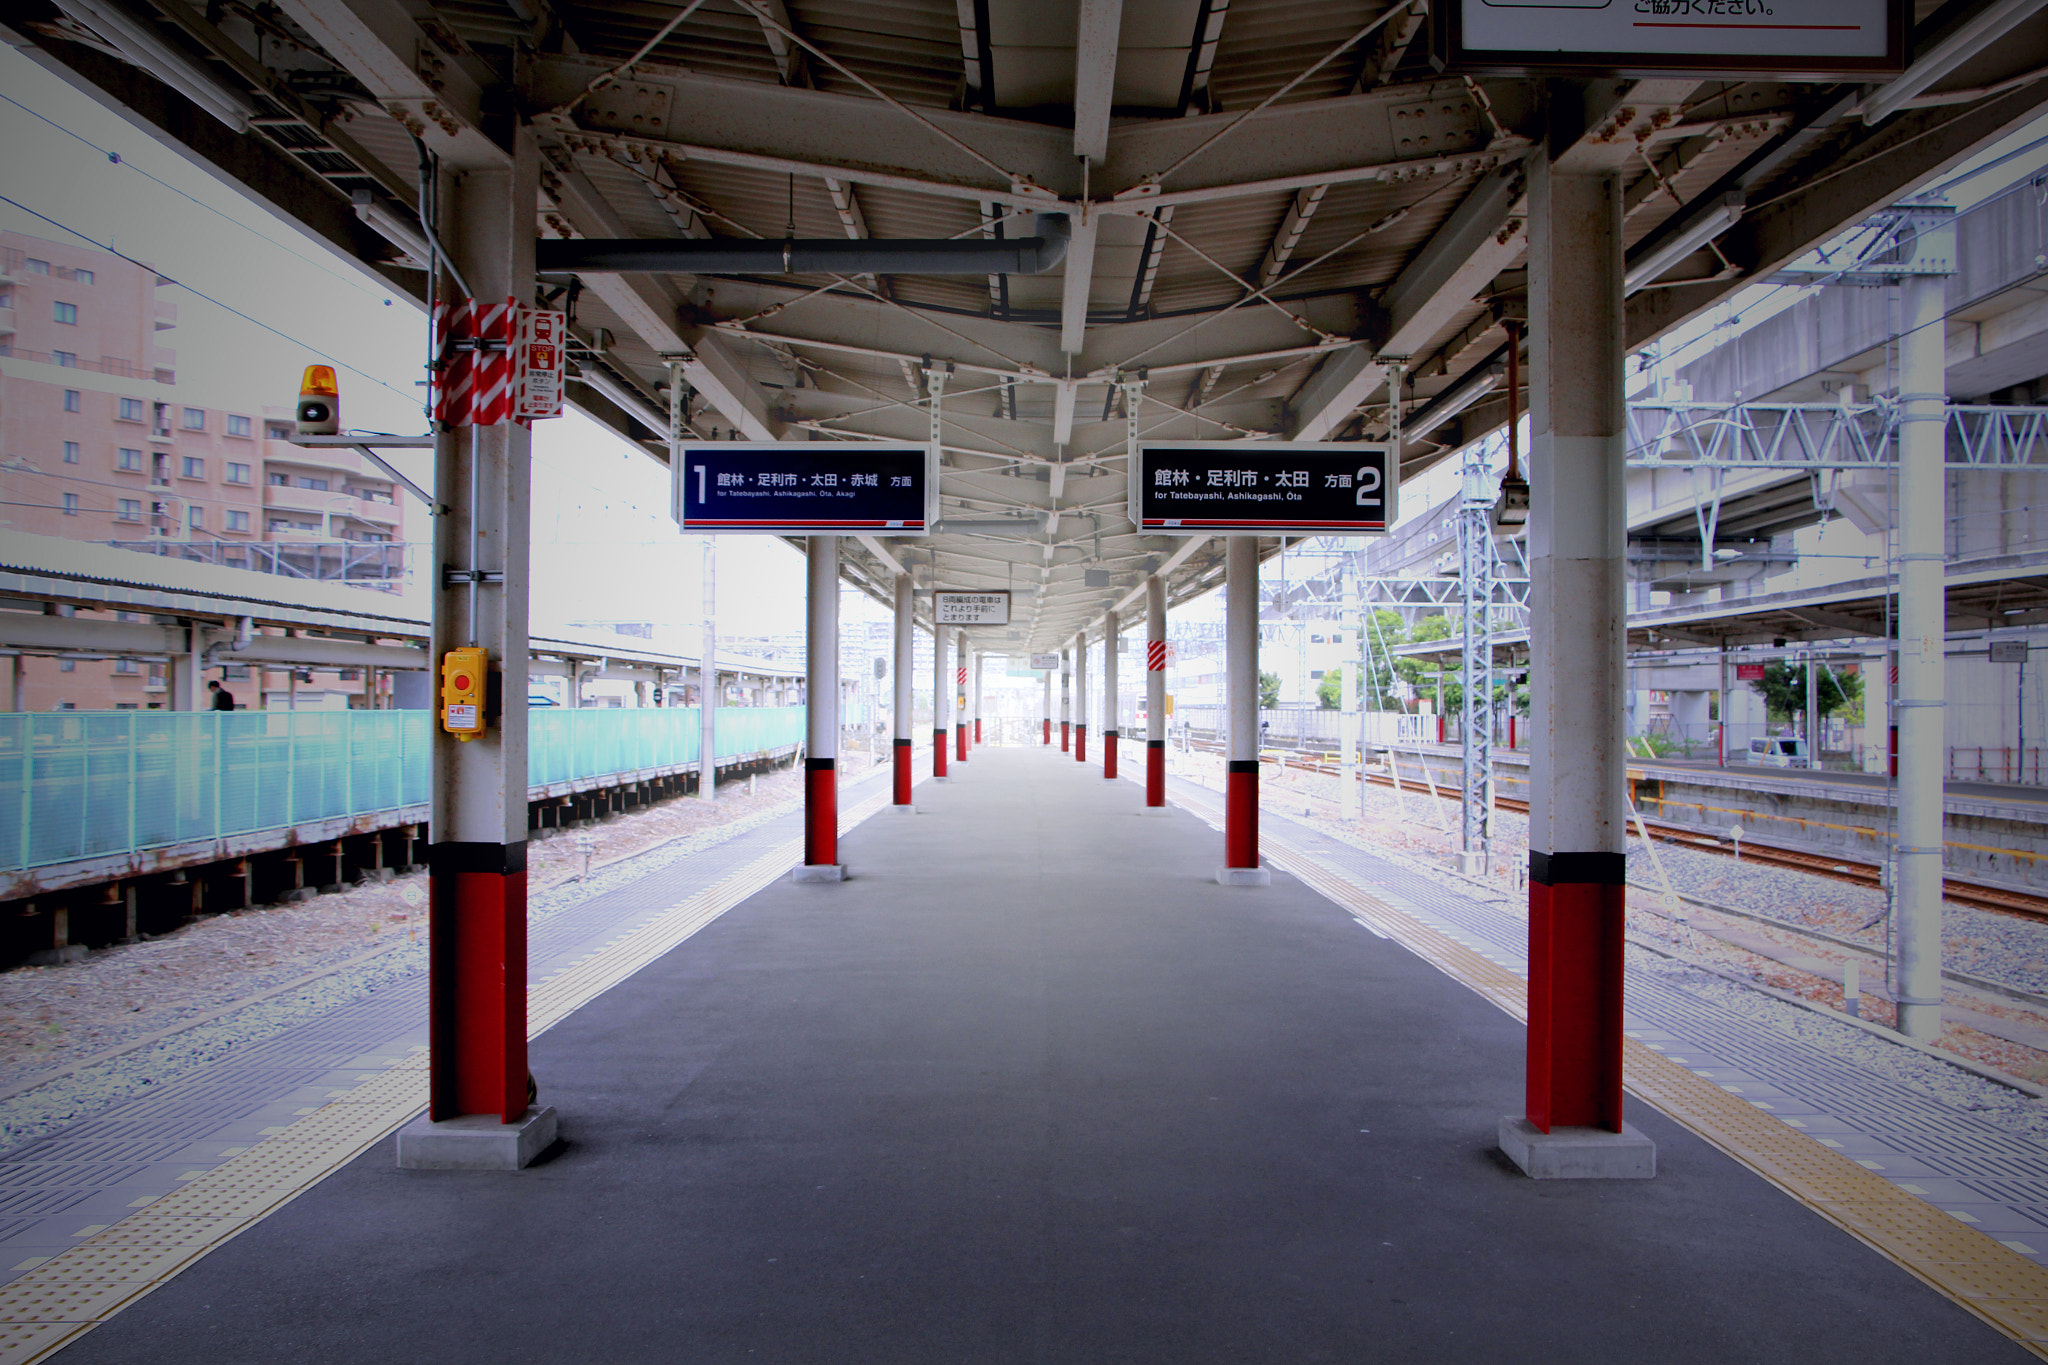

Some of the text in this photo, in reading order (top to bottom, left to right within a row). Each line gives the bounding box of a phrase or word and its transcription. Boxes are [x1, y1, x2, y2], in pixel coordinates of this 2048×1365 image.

[694, 465, 706, 504] 1
[717, 473, 912, 487] 館林・足利市・太田・赤城 方面
[1154, 469, 1352, 488] 館林・足利市・太田 方面
[1356, 466, 1381, 506] 2
[729, 490, 771, 498] Tatebayashi,
[773, 490, 817, 498] Ashikagashi,
[836, 490, 856, 498] Akagi
[1155, 491, 1167, 499] for
[1170, 491, 1225, 501] Tatebayashi,
[1227, 492, 1284, 502] Ashikagashi,
[942, 604, 996, 613] これより手前に
[942, 613, 980, 621] とまります
